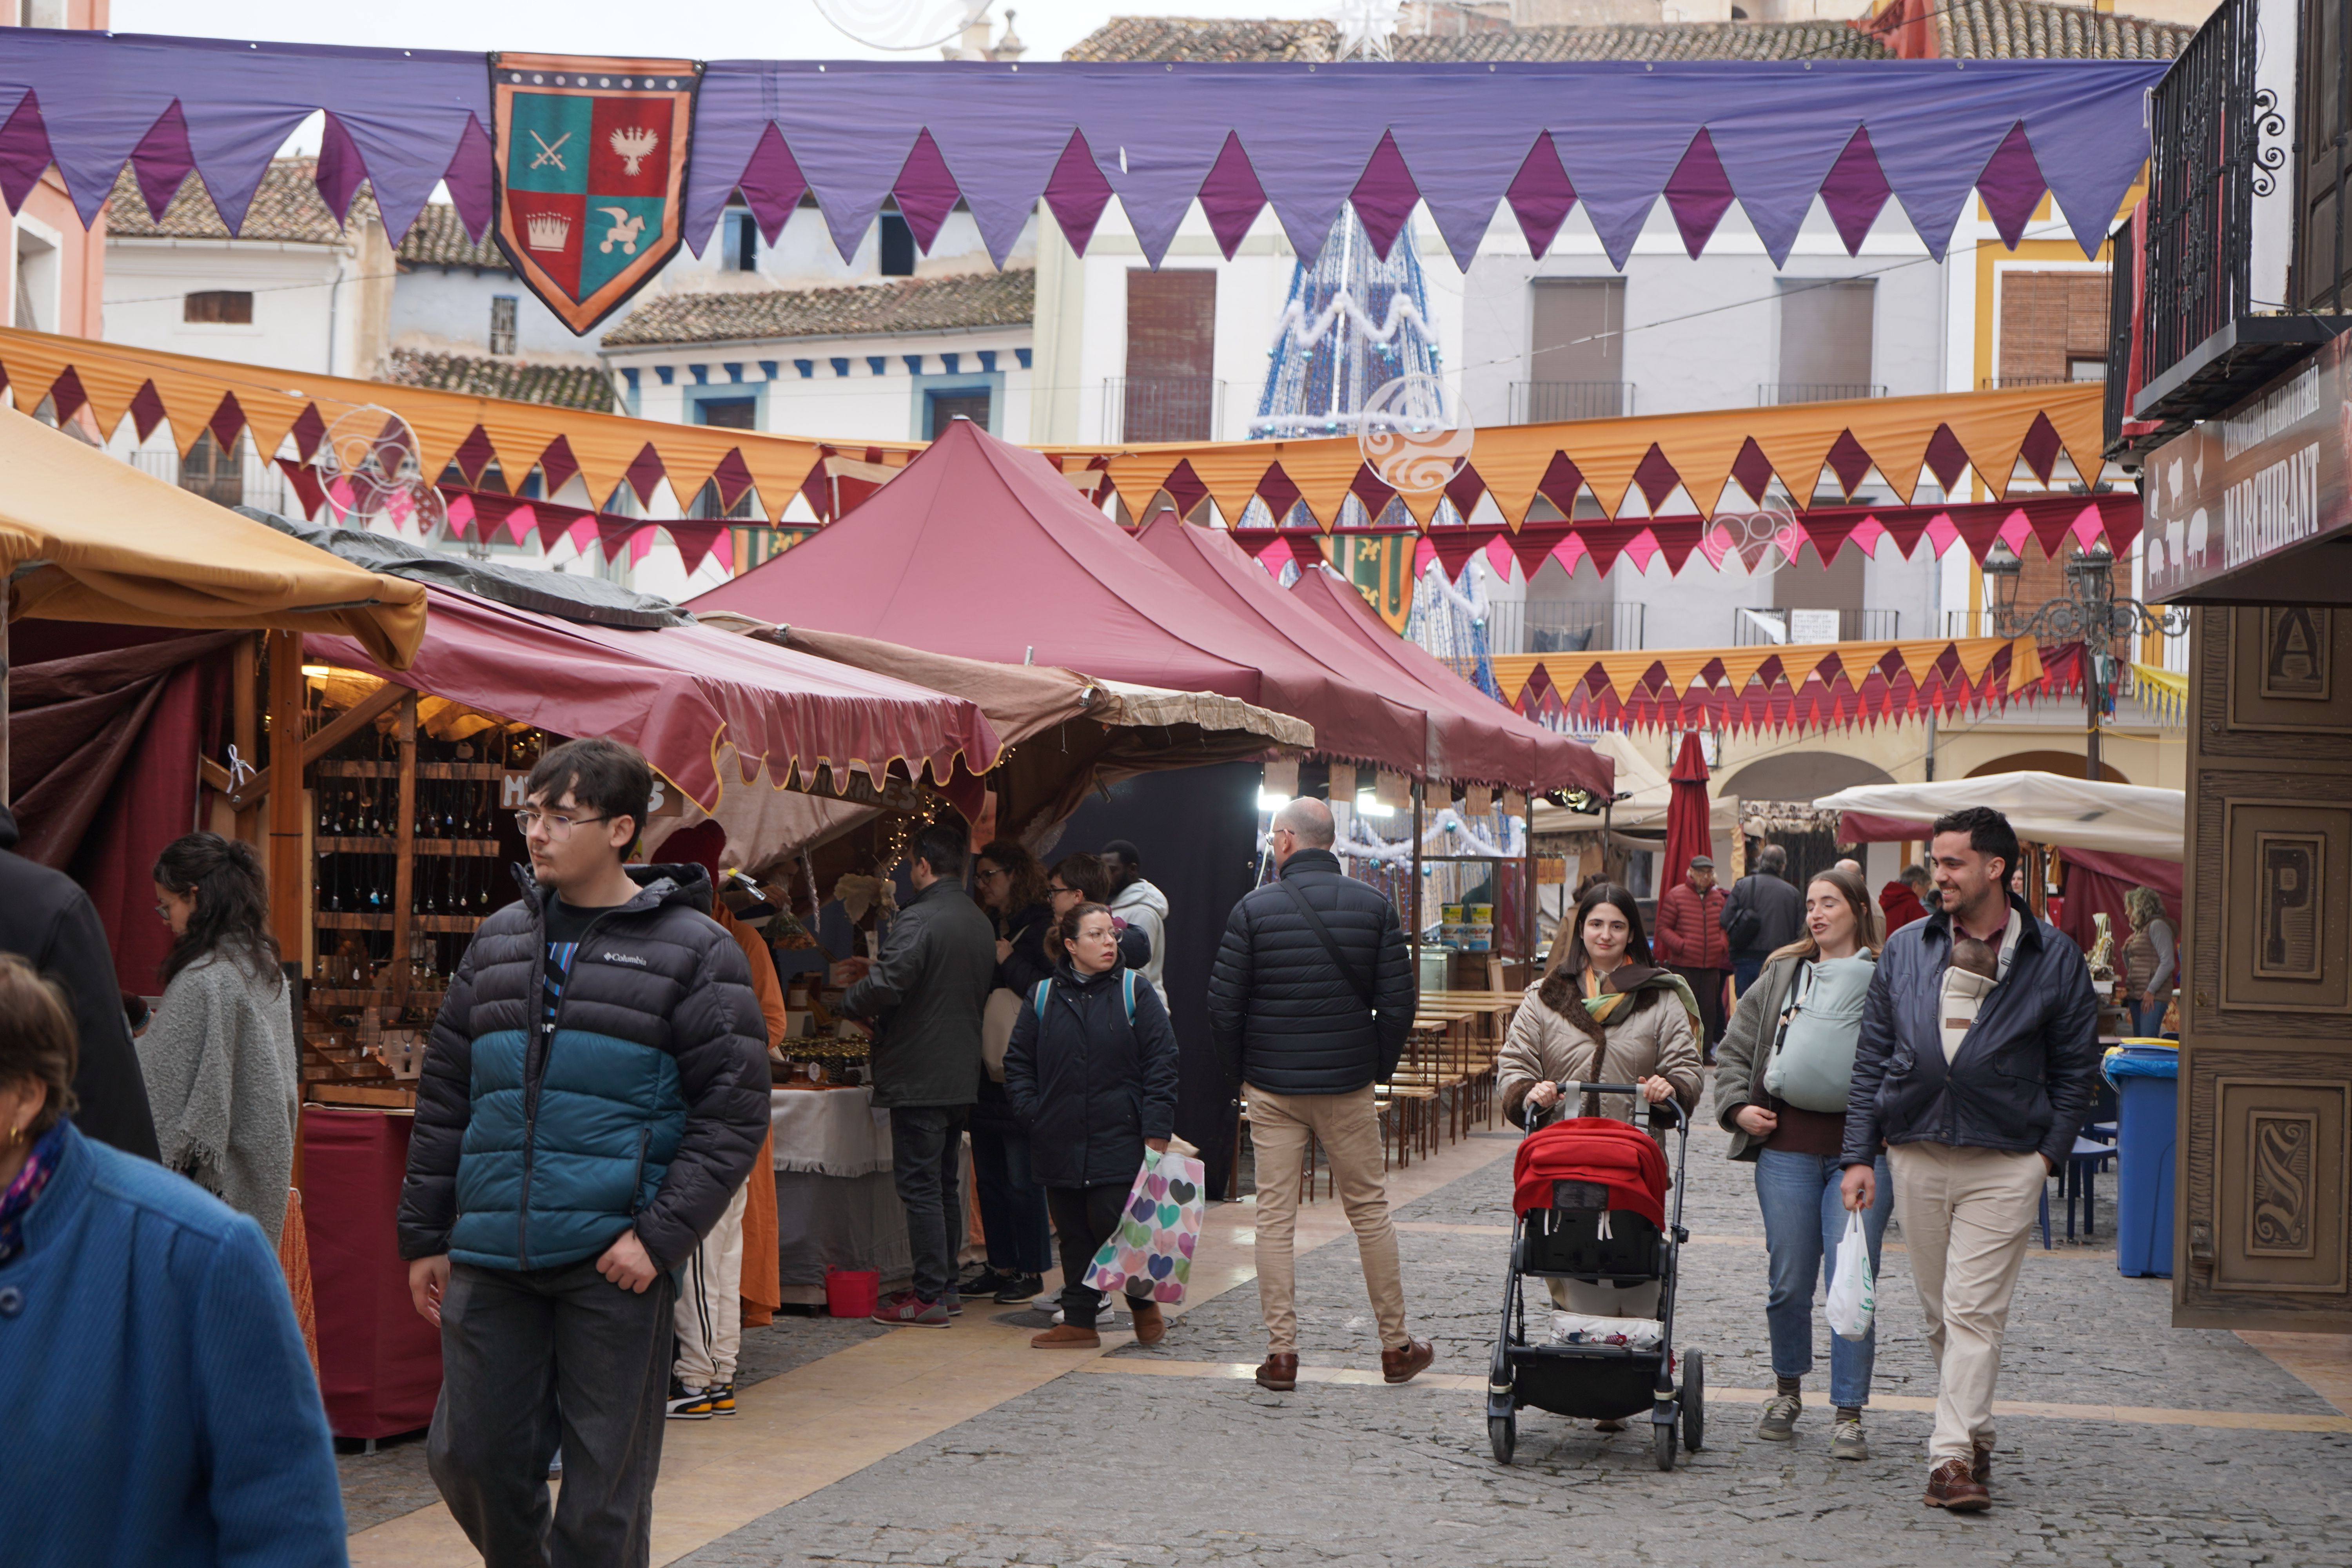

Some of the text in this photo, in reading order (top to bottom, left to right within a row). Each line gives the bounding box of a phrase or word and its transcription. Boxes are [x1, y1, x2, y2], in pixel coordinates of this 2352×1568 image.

[2225, 357, 2320, 462] CARNICERÍA CHARCUTERÍA
[2224, 441, 2319, 570] MARCHIRANT
[612, 953, 646, 966] Columbia
[2267, 848, 2312, 964] P
